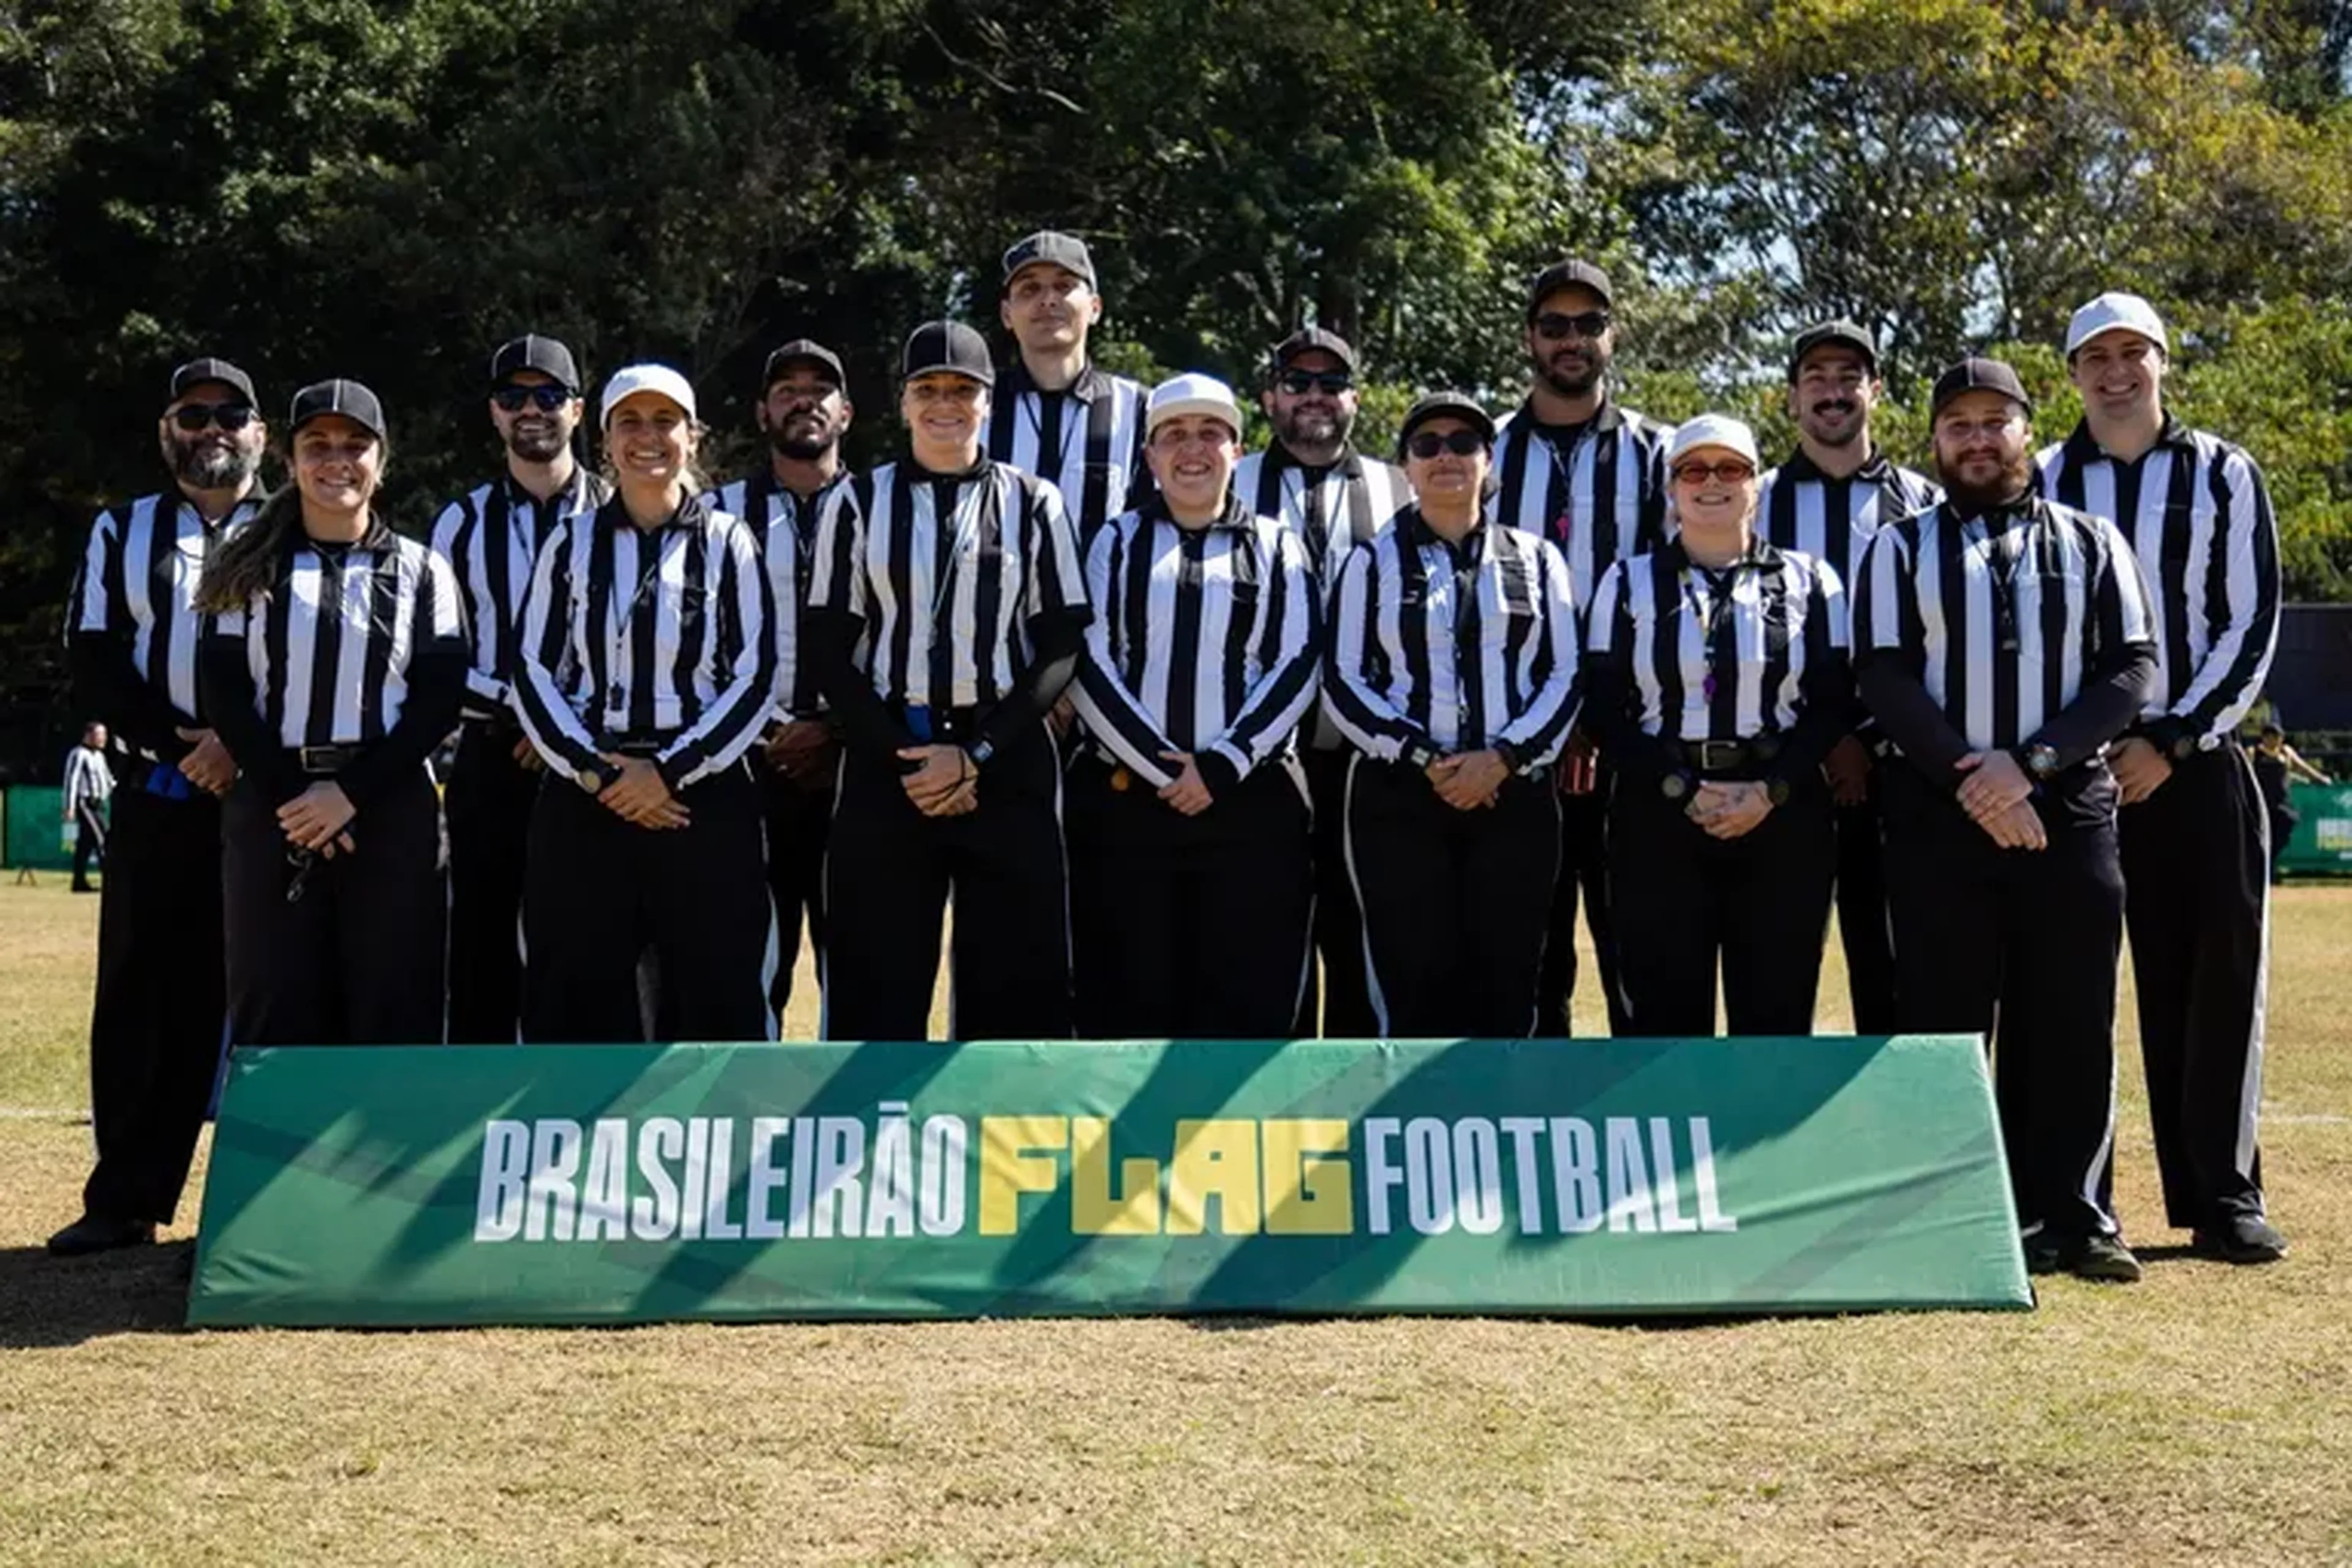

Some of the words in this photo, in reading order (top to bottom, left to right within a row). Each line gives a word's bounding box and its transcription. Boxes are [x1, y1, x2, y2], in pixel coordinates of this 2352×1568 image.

[475, 1101, 966, 1242] BRASILEIRÃO
[979, 1117, 1352, 1235] FLAG
[1365, 1117, 1737, 1234] FOOTBALL
